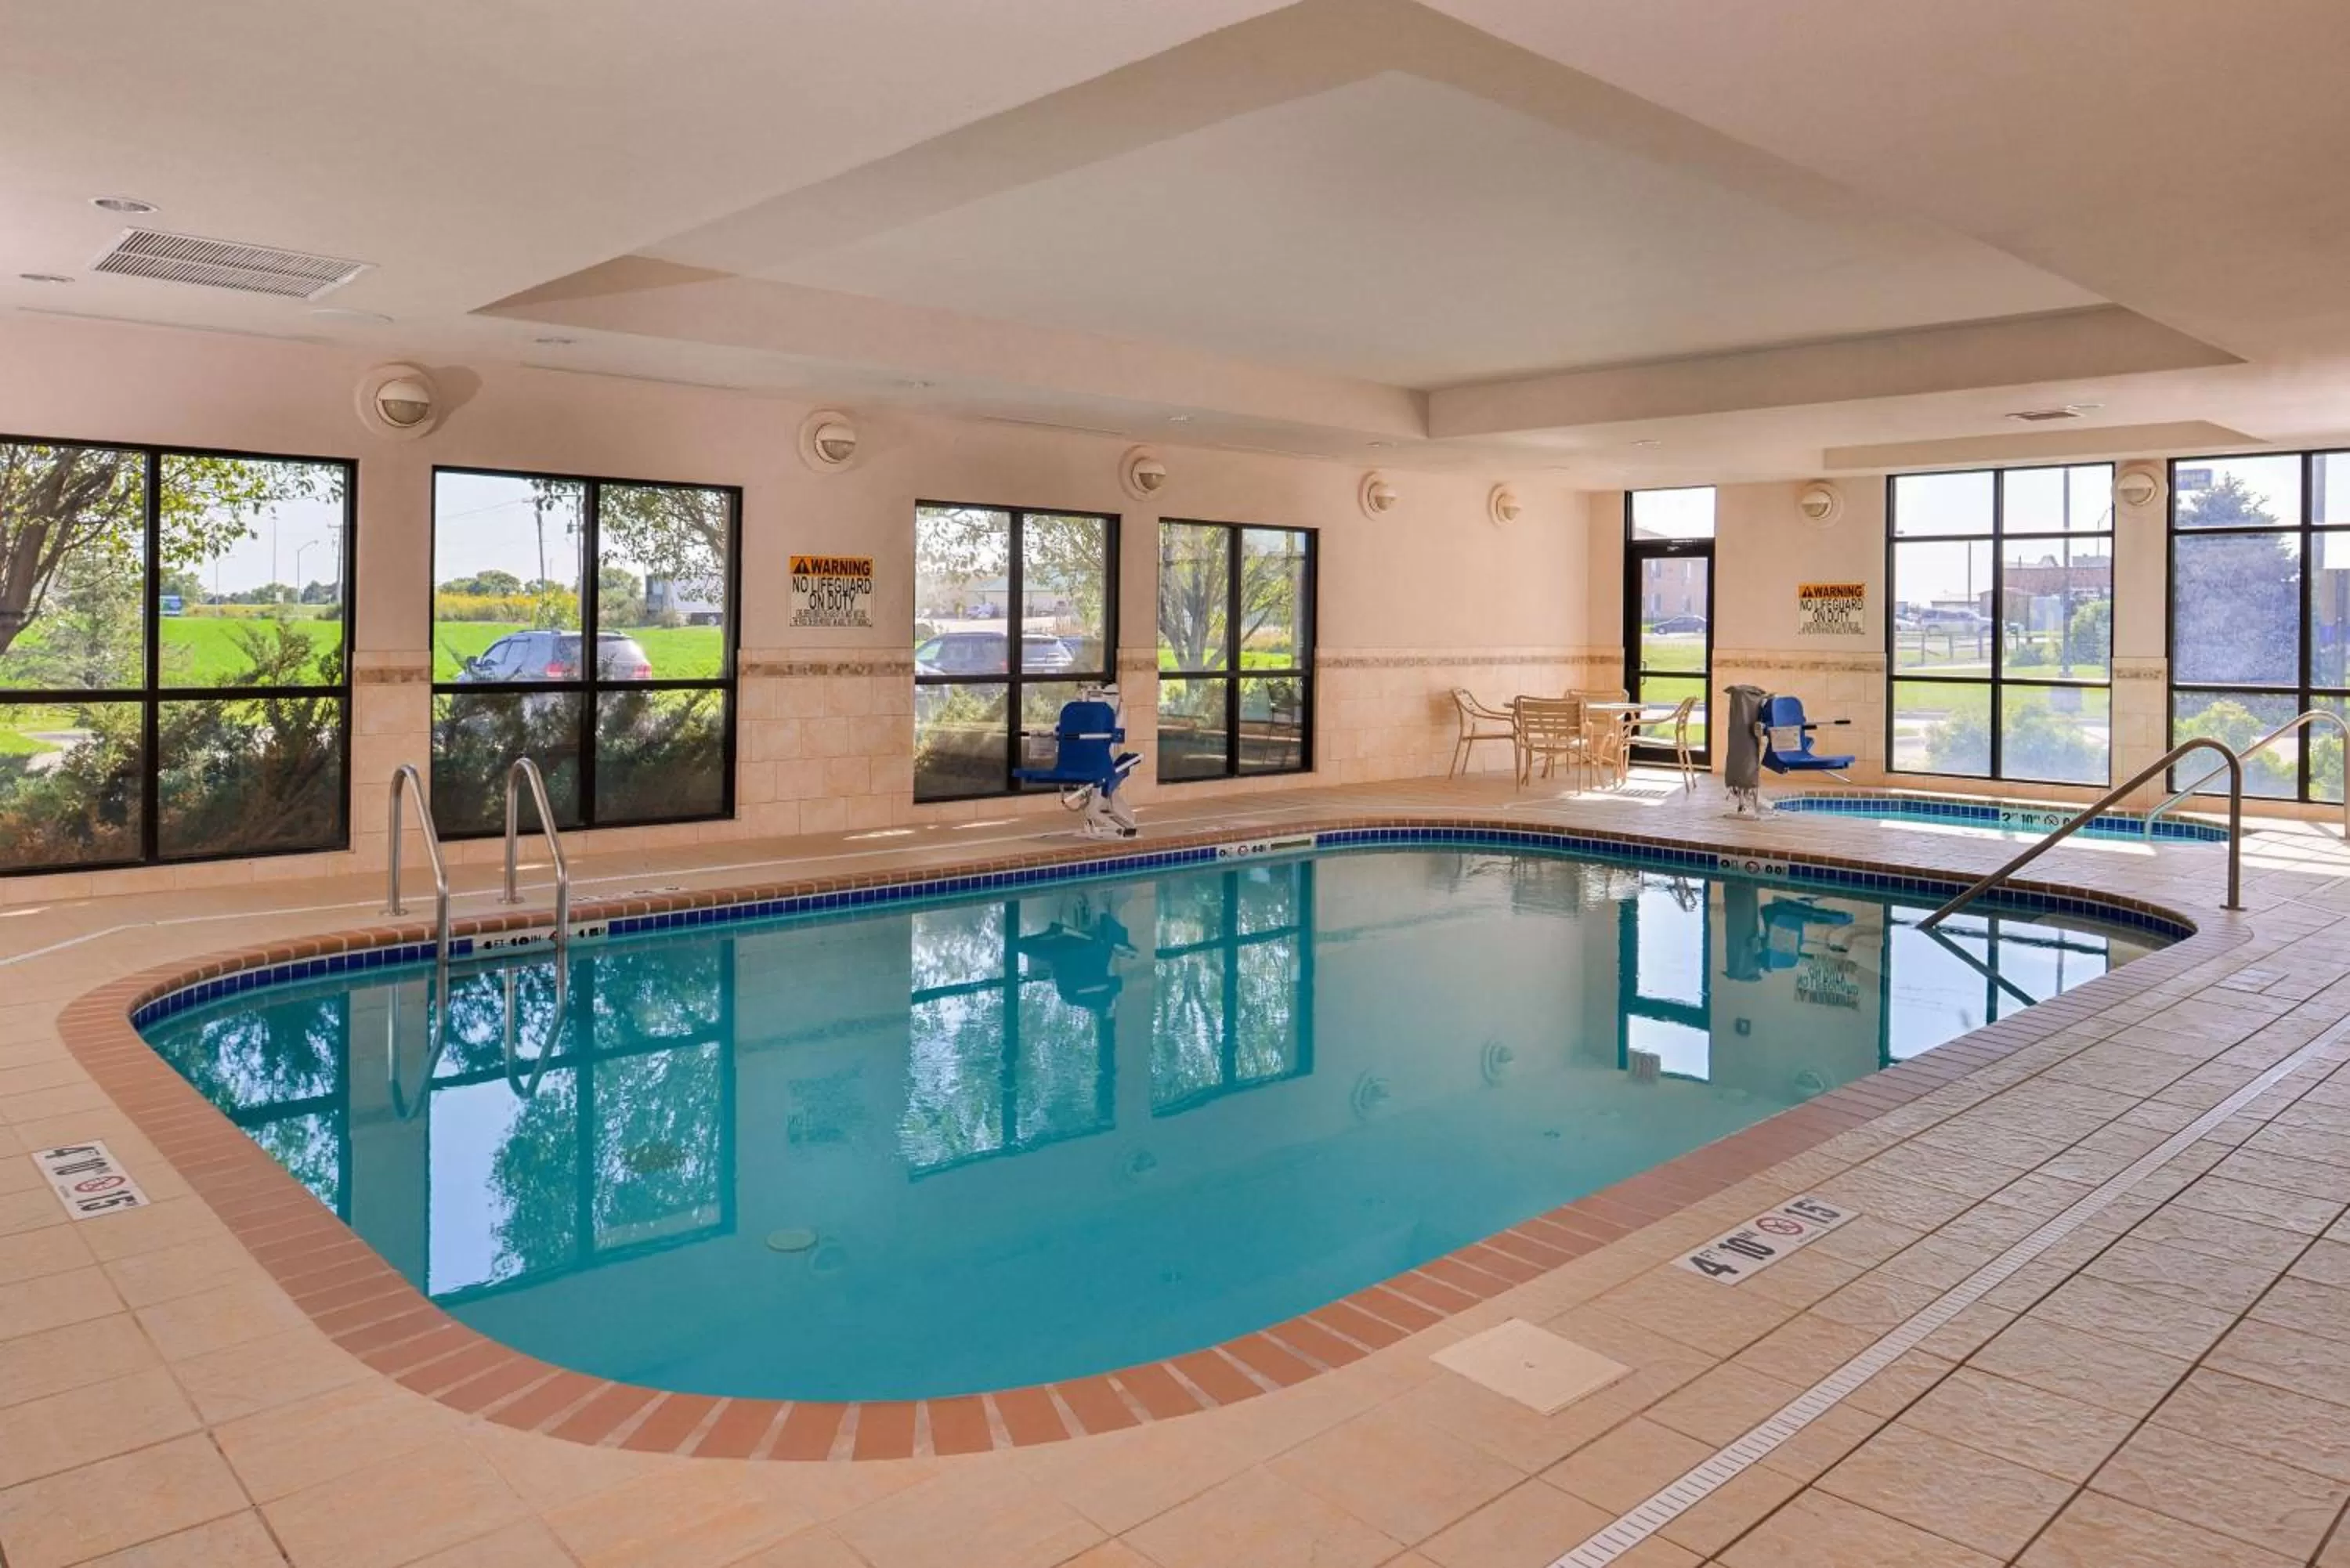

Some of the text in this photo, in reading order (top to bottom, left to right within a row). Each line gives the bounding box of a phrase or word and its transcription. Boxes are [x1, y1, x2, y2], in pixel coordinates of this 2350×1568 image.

[811, 558, 870, 576] WARNING
[792, 576, 872, 594] NO LIFEGUARD
[1813, 585, 1862, 598] WARNING
[808, 592, 856, 611] ON DUTY
[1799, 598, 1864, 612] NO LIFEGUARD
[1812, 608, 1826, 623] ON
[1689, 1255, 1740, 1277] 4
[1717, 1237, 1776, 1260] 10
